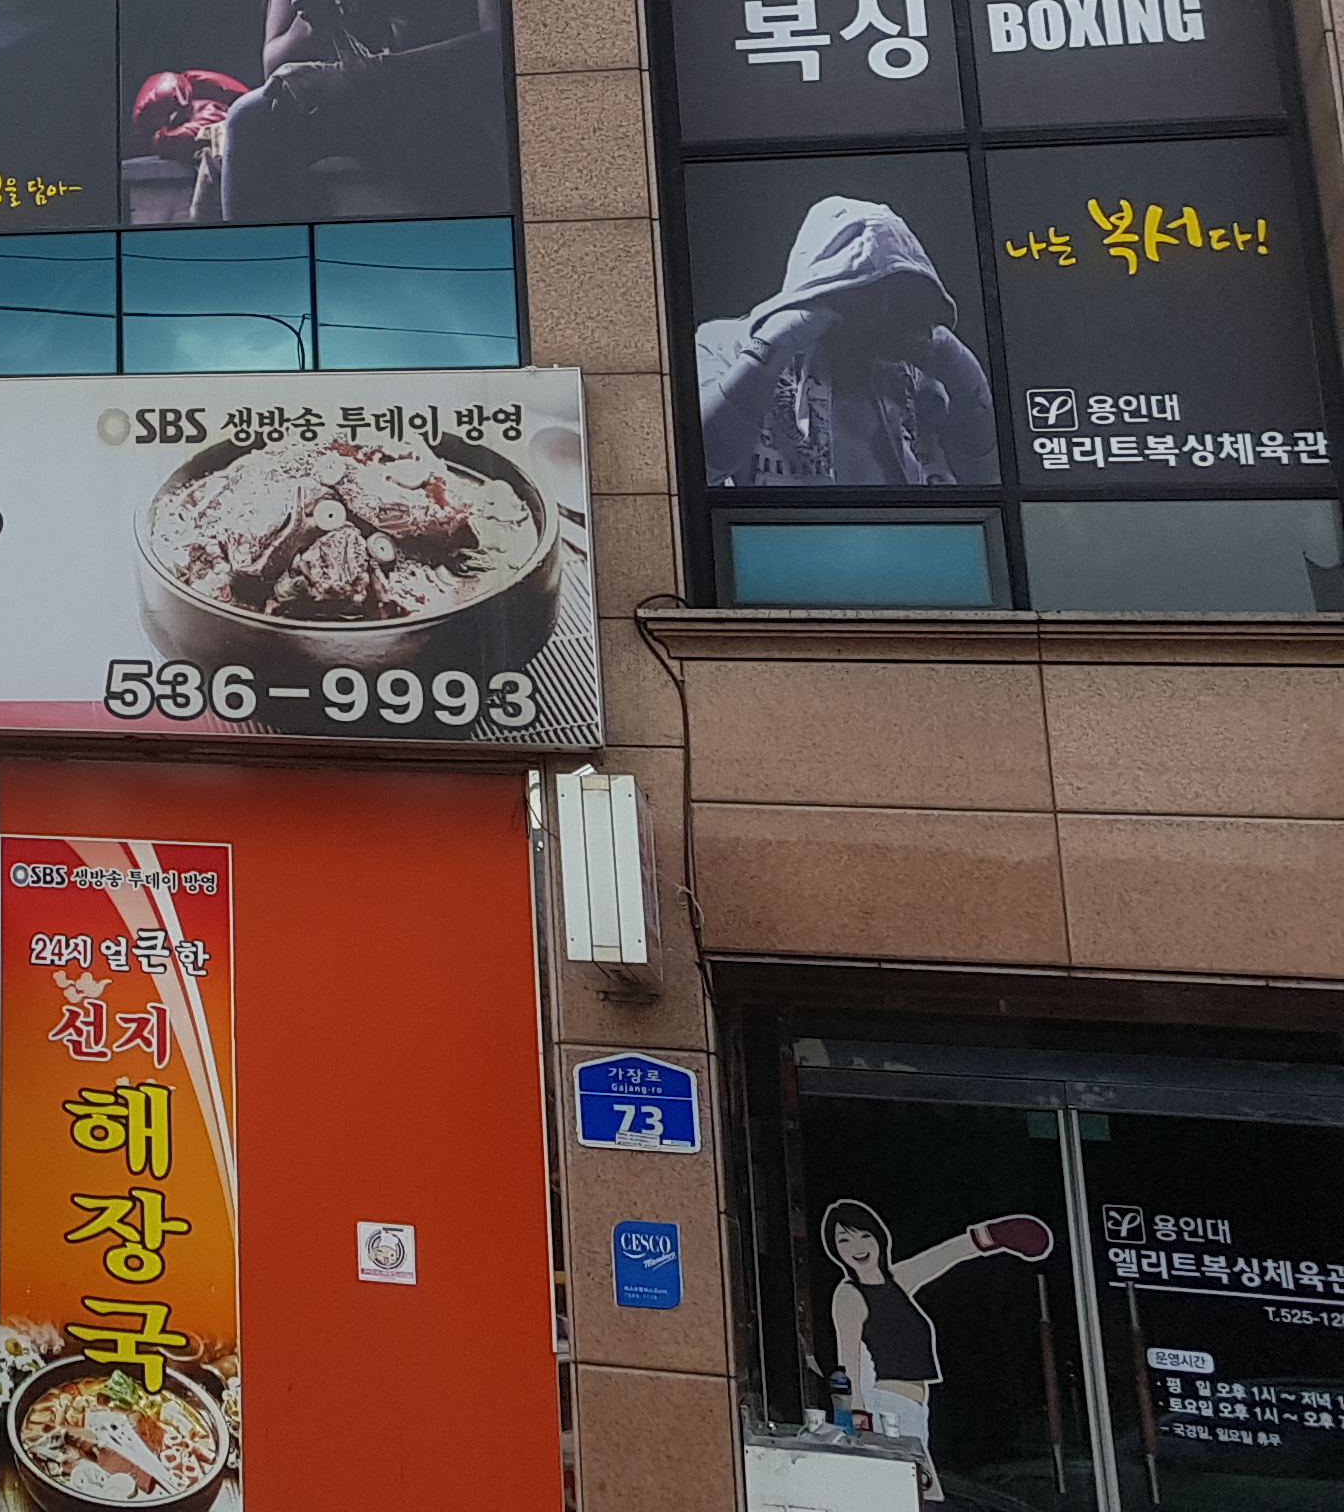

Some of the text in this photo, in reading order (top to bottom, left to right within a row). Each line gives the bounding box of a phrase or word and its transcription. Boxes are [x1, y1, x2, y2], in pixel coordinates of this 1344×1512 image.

[1005, 197, 1269, 276] 나는 복서다!
[134, 403, 524, 445] SBS 생방송 투데이 방영
[1086, 392, 1181, 425] 용인대
[1032, 430, 1331, 471] 엘리트복싱체육관
[103, 657, 540, 728] 536-9993
[29, 864, 218, 894] SBS 생방송 투데이 방영
[28, 927, 211, 977] 24시 얼큰한
[48, 998, 171, 1069] 선지
[608, 1067, 662, 1083] 가장로
[610, 1082, 663, 1094] Gajang-ro
[613, 1103, 664, 1137] 73
[62, 1082, 193, 1394] 해장국
[620, 1232, 672, 1254] CESCO
[1152, 1214, 1233, 1244] 용인대
[1154, 1350, 1206, 1369] 운영시간
[1168, 1398, 1214, 1418] 토요일
[1253, 1407, 1280, 1425] 1시
[1250, 1386, 1278, 1404] 1시
